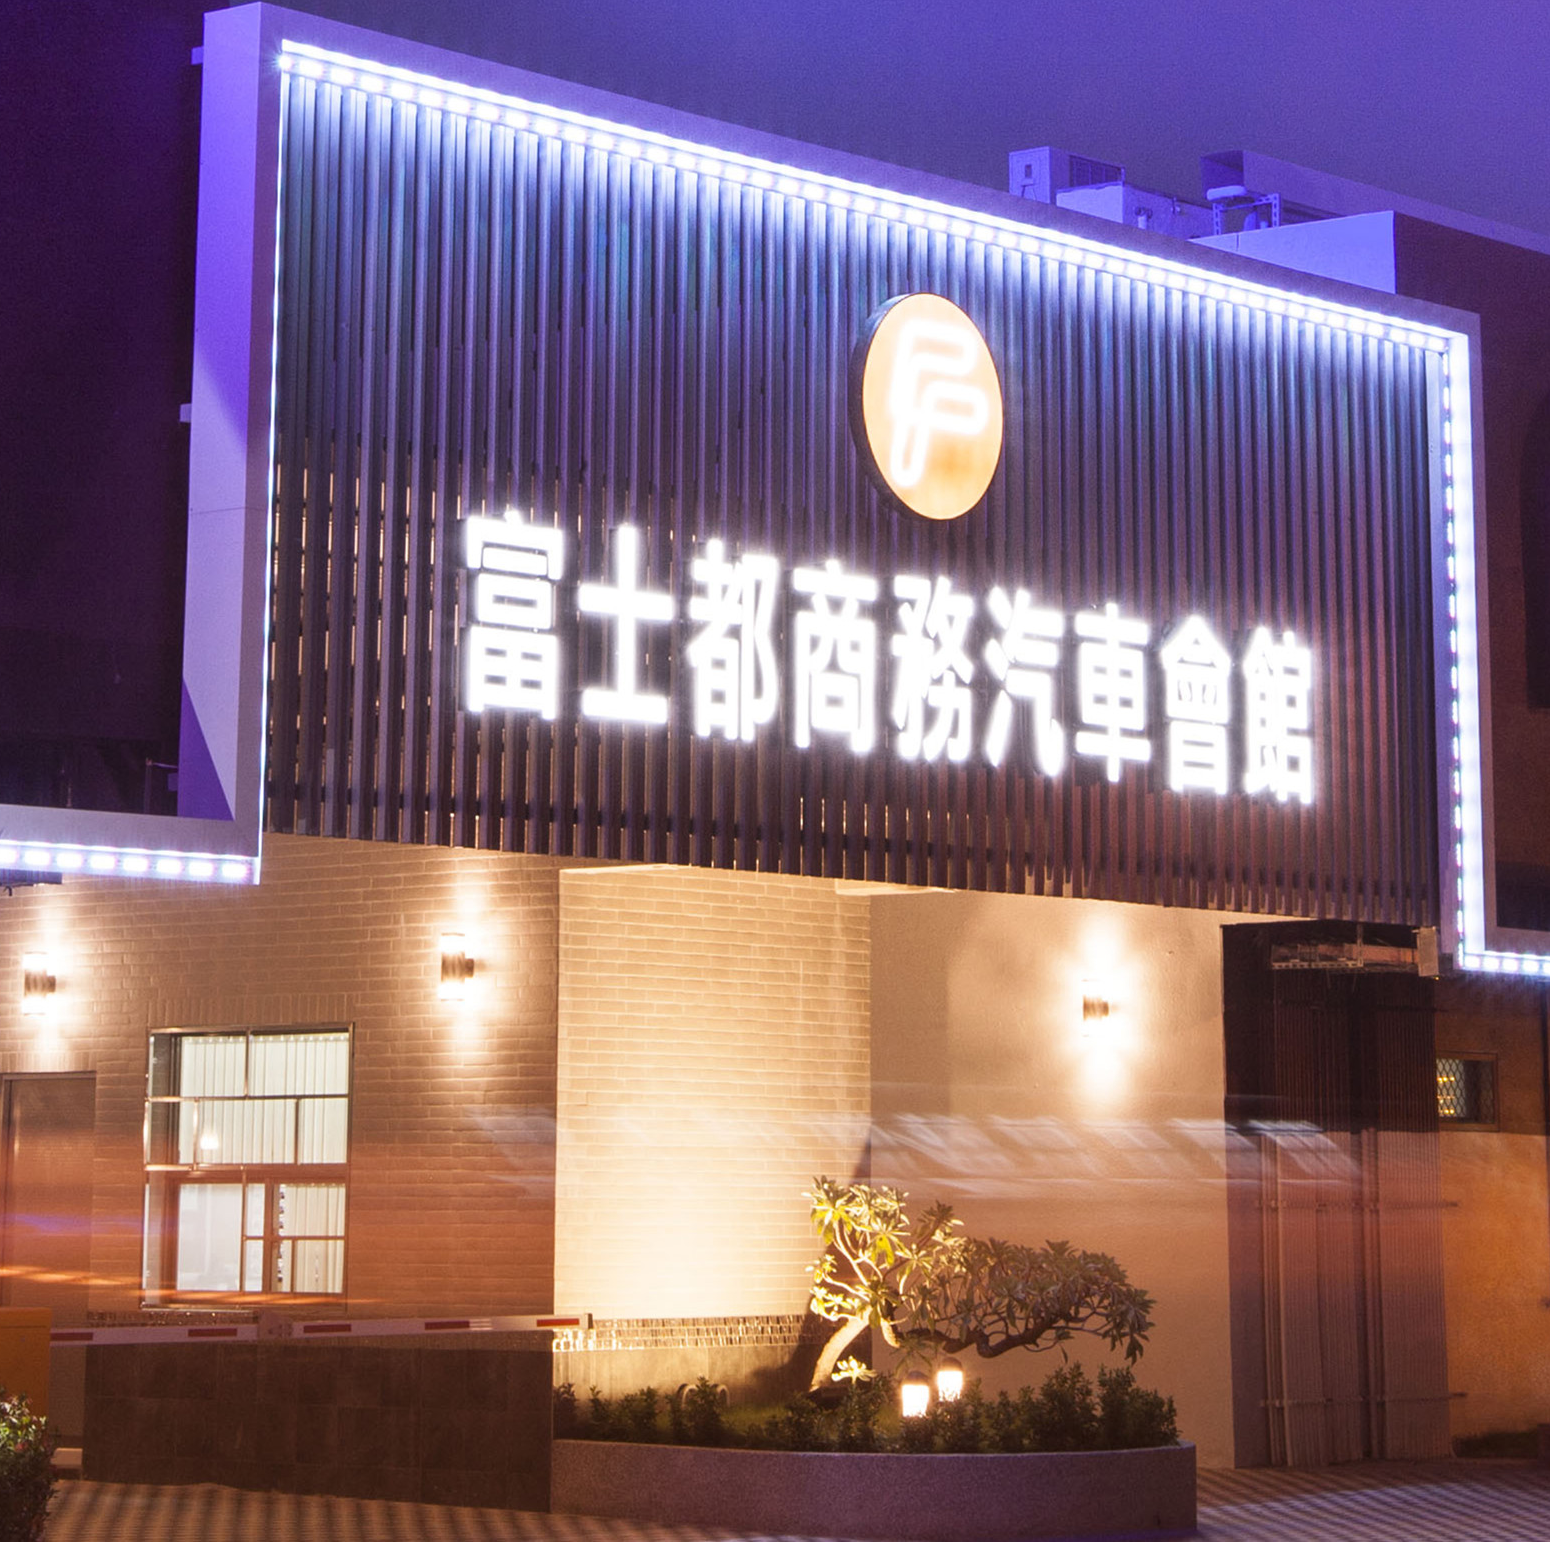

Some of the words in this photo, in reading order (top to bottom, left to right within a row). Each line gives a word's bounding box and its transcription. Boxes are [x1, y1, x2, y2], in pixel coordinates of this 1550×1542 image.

[462, 510, 1315, 805] 富士都商務汽車會館
